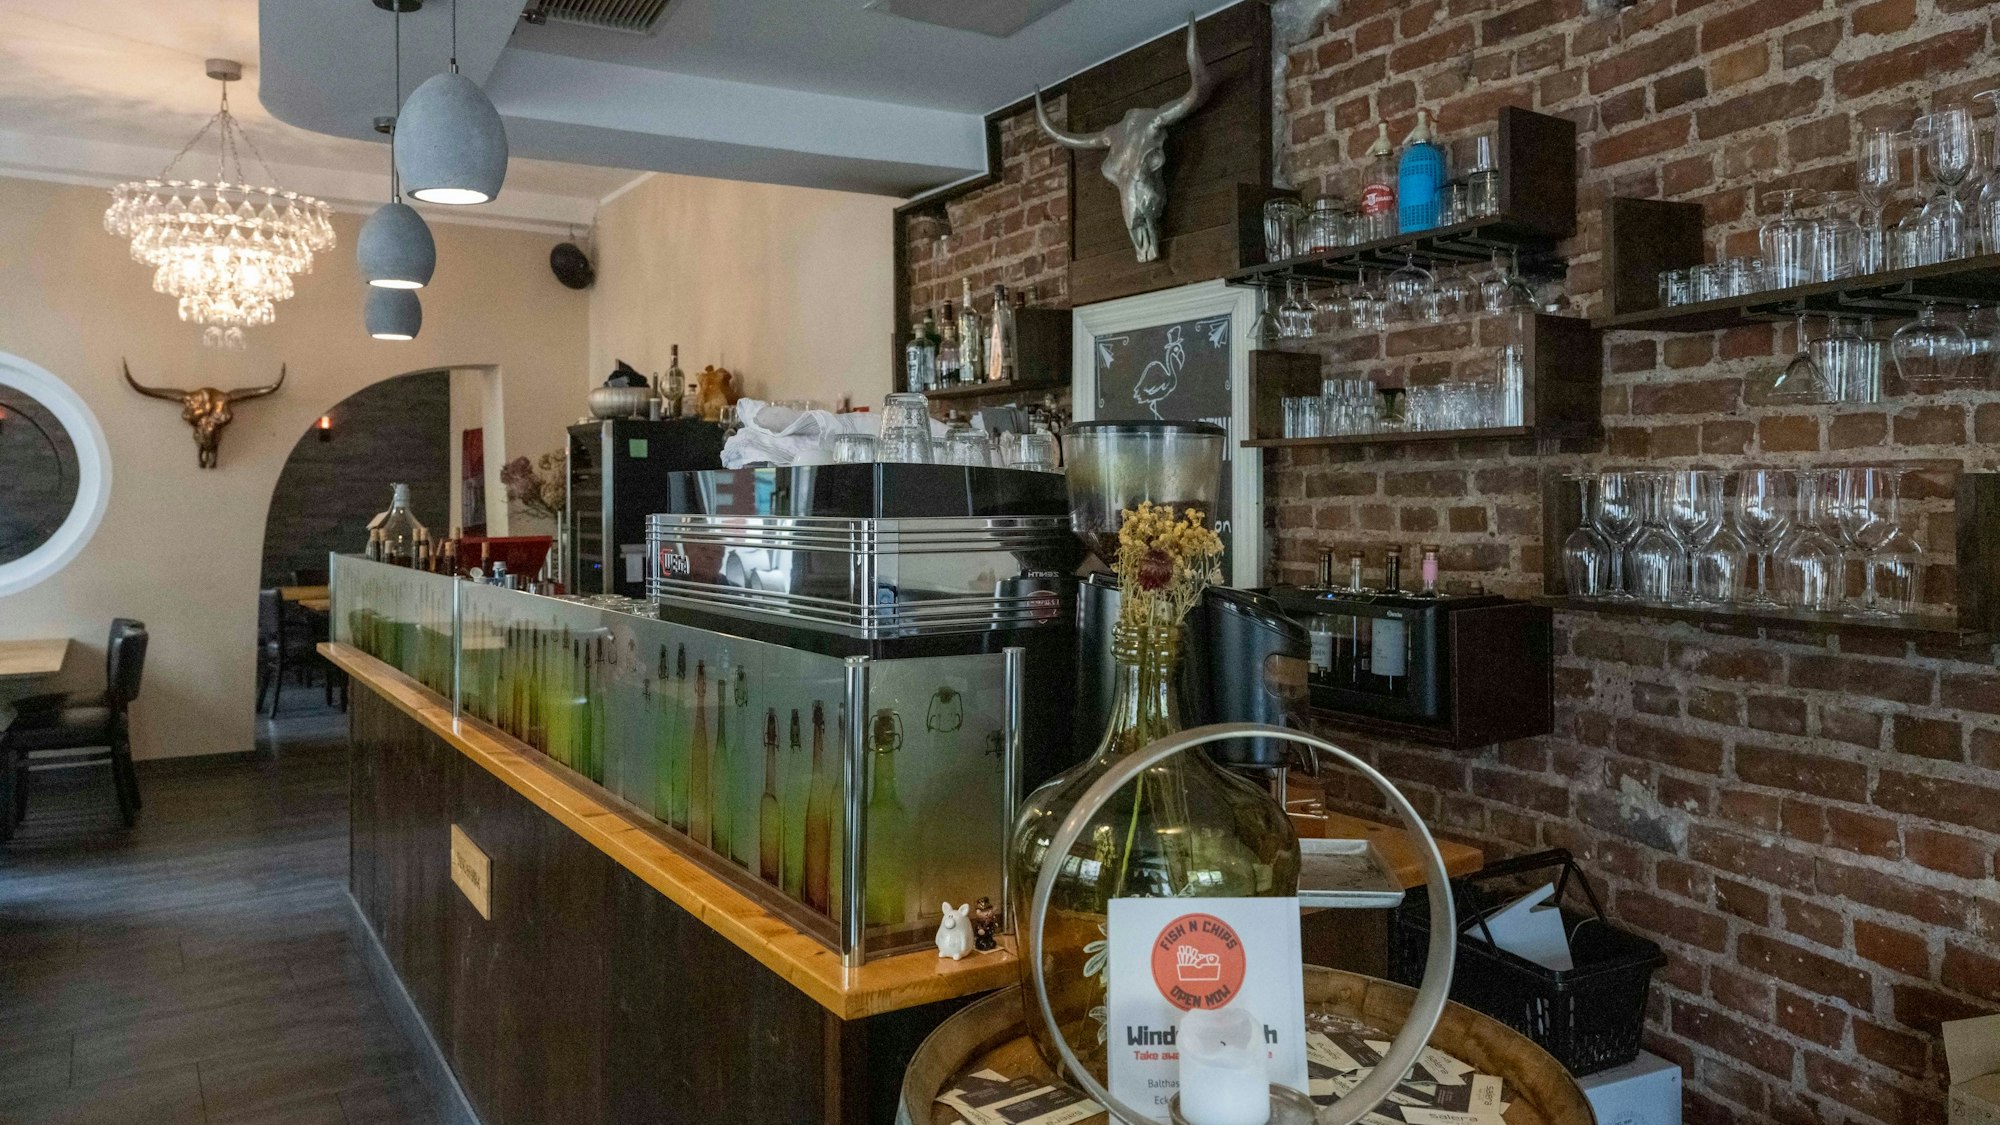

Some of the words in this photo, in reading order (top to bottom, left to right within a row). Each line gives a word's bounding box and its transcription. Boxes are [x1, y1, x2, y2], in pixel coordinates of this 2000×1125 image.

[664, 553, 690, 574] WEGA
[1160, 924, 1186, 951] FISH
[1189, 920, 1198, 932] N
[1202, 921, 1238, 950] CHIPS
[1170, 984, 1202, 1008] OPEN
[1205, 984, 1231, 1006] NOW
[1127, 1025, 1178, 1046] Wind
[1133, 1050, 1159, 1061] Take
[1161, 1052, 1180, 1061] awa
[1147, 1078, 1180, 1088] Balthas
[1154, 1095, 1169, 1105] Eck
[1428, 1113, 1478, 1122] salera
